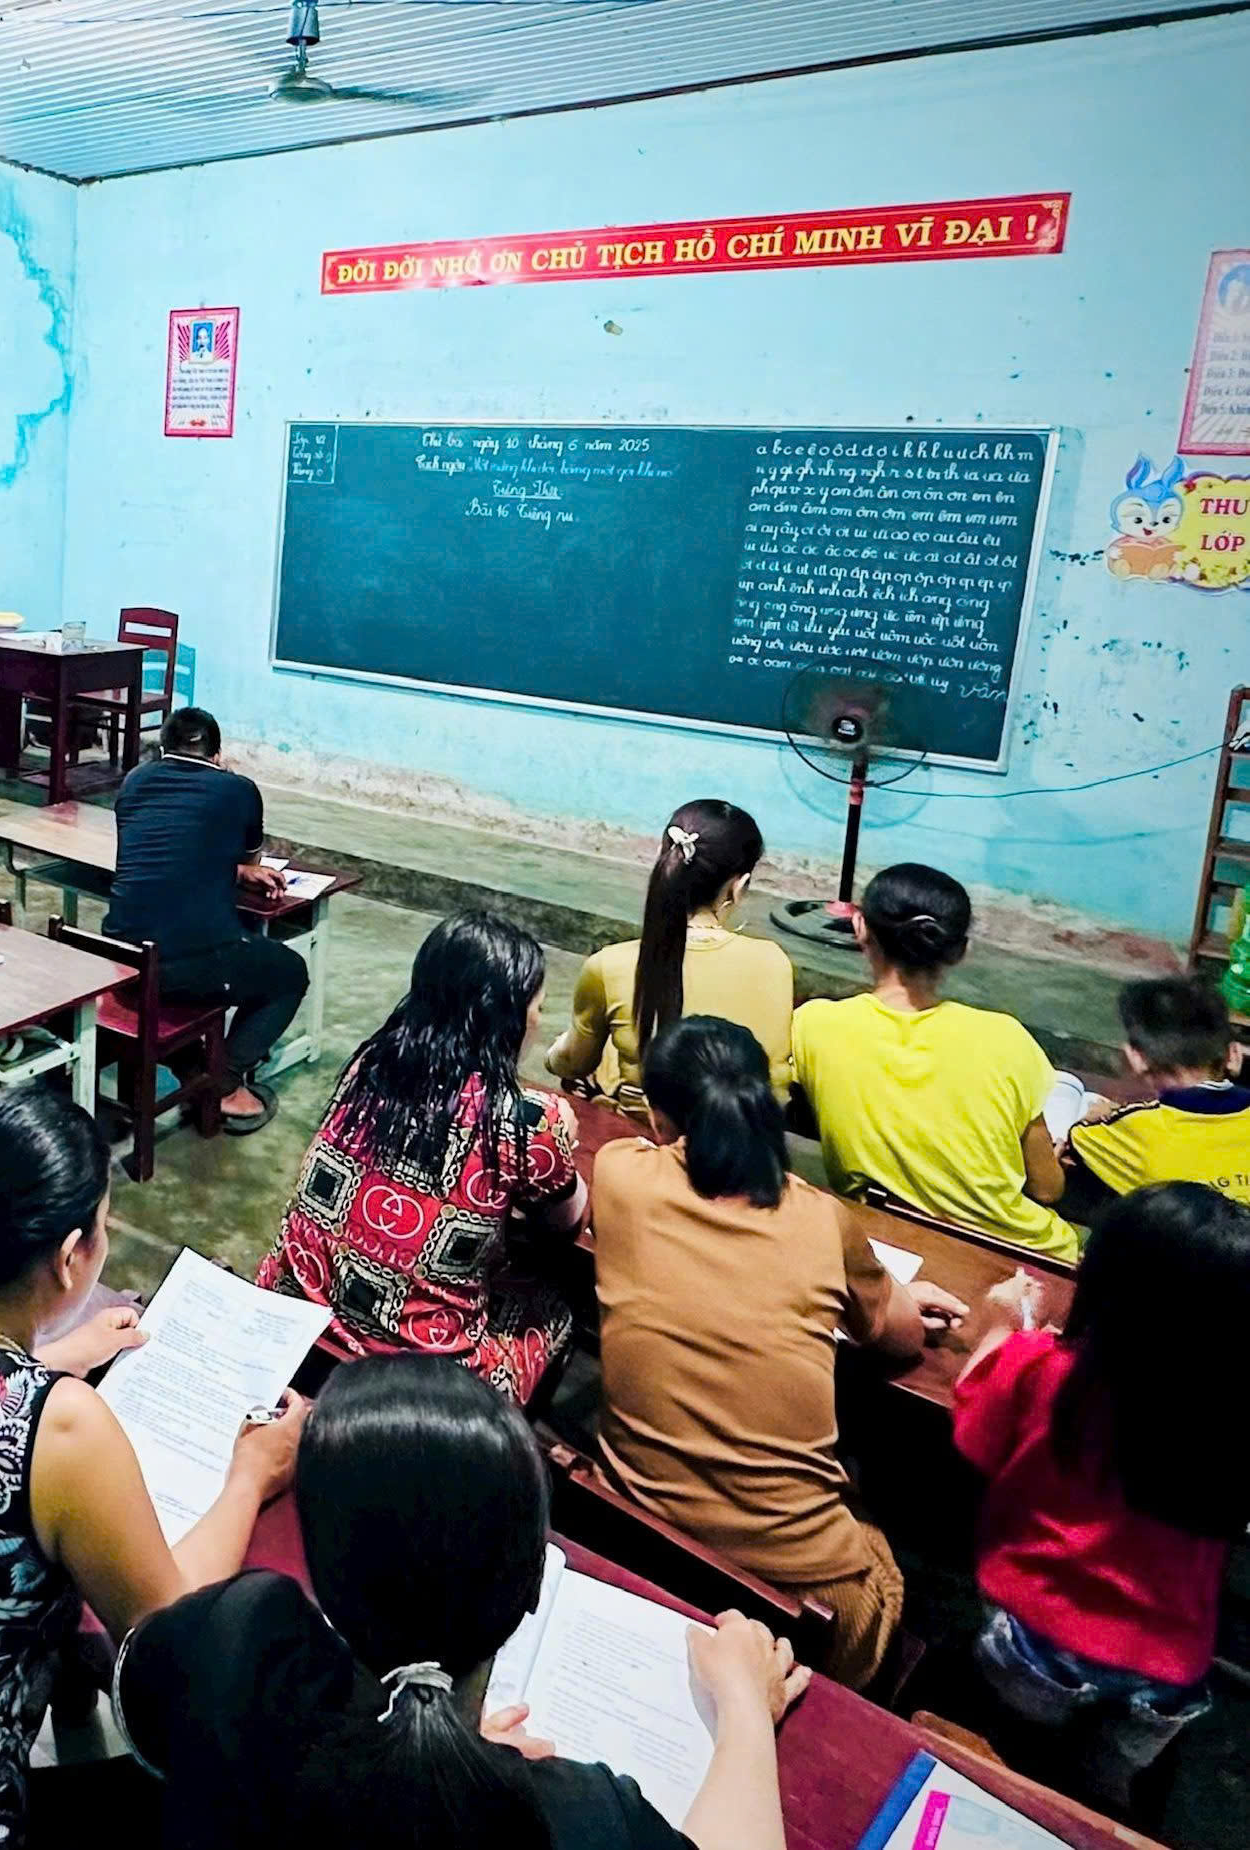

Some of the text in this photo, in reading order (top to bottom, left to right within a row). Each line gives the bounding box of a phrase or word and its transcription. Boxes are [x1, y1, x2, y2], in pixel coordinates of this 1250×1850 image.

[338, 215, 1037, 283] ĐỜI ĐỜI NHỚ ƠN CHỦ TỊCH HỒ CHÍ MINH VĨ ĐẠI !
[472, 436, 500, 455] ngày
[528, 433, 564, 457] tháng
[568, 439, 579, 451] 6
[585, 439, 613, 451] năm
[618, 438, 651, 452] 2025
[756, 446, 768, 456] a
[772, 438, 783, 455] b
[783, 446, 793, 456] c
[795, 446, 805, 456] e
[807, 443, 817, 457] ê
[819, 446, 830, 456] o
[832, 443, 844, 457] ô
[845, 443, 859, 457] d
[903, 441, 914, 458] k
[917, 441, 928, 458] h
[931, 441, 941, 458] l
[943, 449, 954, 459] u
[969, 443, 991, 460] ch
[993, 443, 1016, 460] kh
[1017, 451, 1033, 461] m
[795, 458, 816, 481] gh
[818, 459, 836, 476] nh
[838, 468, 857, 483] ng
[861, 460, 886, 483] ngh
[889, 468, 900, 478] r
[943, 462, 960, 480] th
[750, 478, 768, 497] ph
[803, 486, 816, 496] x
[819, 487, 830, 504] y
[876, 485, 899, 499] ân
[901, 490, 921, 499] on
[465, 497, 492, 517] Bài
[497, 504, 510, 518] 16
[517, 503, 551, 531] Tiếng
[801, 502, 828, 515] âm
[830, 507, 852, 517] om
[761, 525, 778, 541] ay
[780, 521, 799, 542] ây
[891, 531, 910, 541] ao
[912, 532, 929, 543] eo
[933, 532, 954, 543] au
[957, 531, 979, 545] âu
[1201, 531, 1246, 552] LỚP
[758, 576, 784, 592] anh
